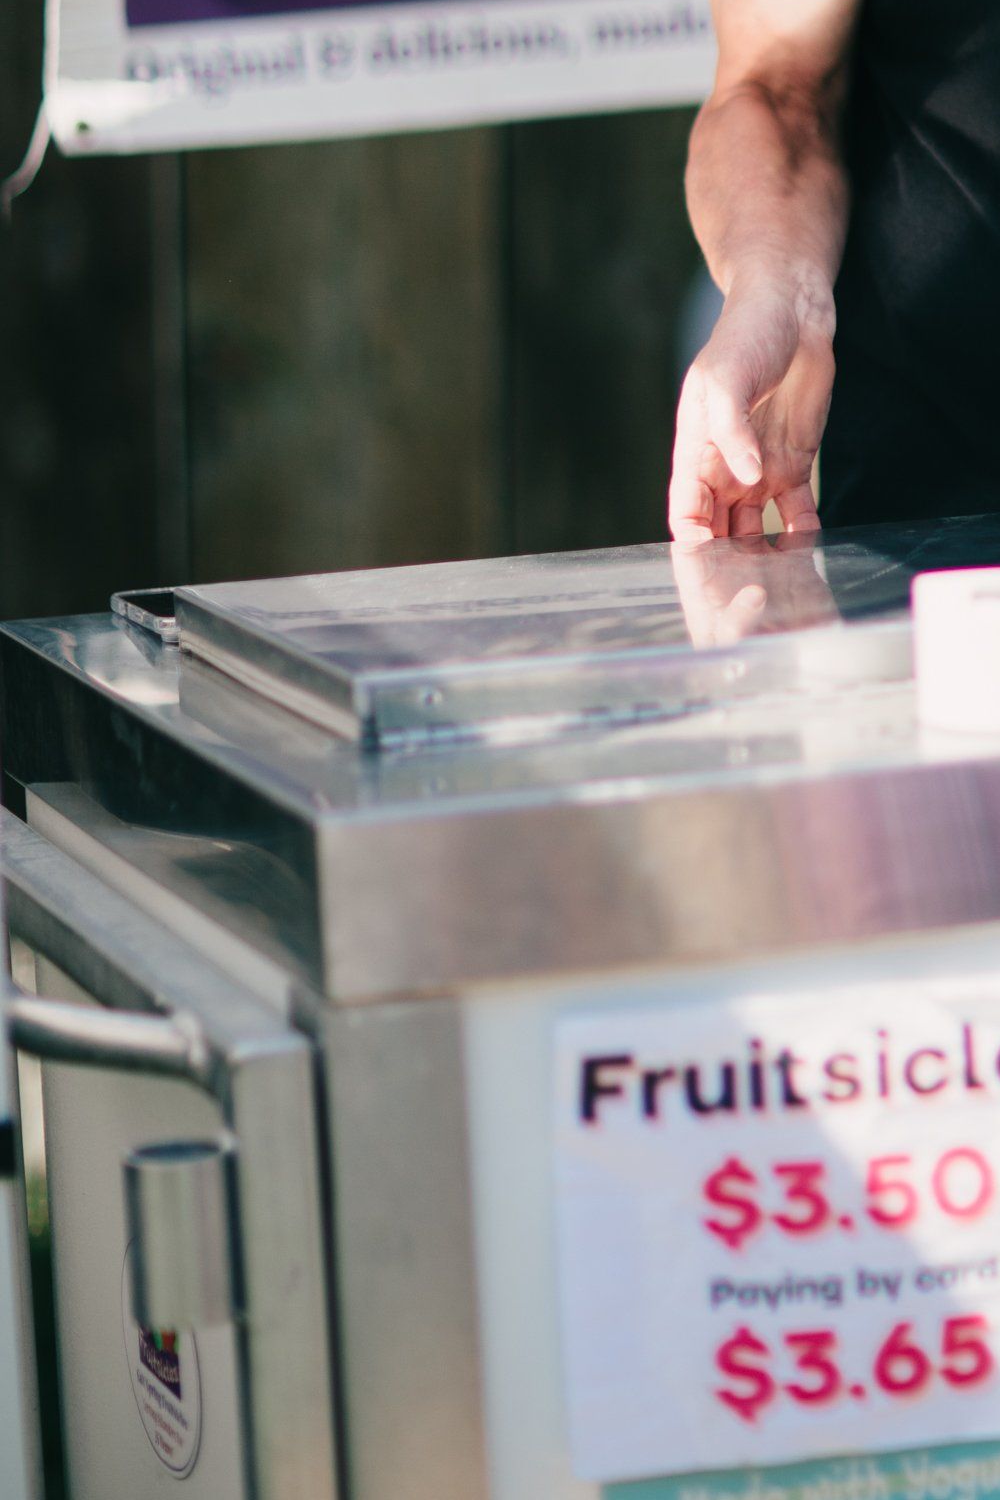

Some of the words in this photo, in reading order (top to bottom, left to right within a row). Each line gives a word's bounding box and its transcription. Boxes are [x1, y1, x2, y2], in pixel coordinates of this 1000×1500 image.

[704, 1147, 994, 1248] $3.50
[711, 1273, 843, 1309] Paying
[857, 1265, 902, 1301] by
[914, 1256, 999, 1292] card
[715, 1315, 993, 1422] $3.65
